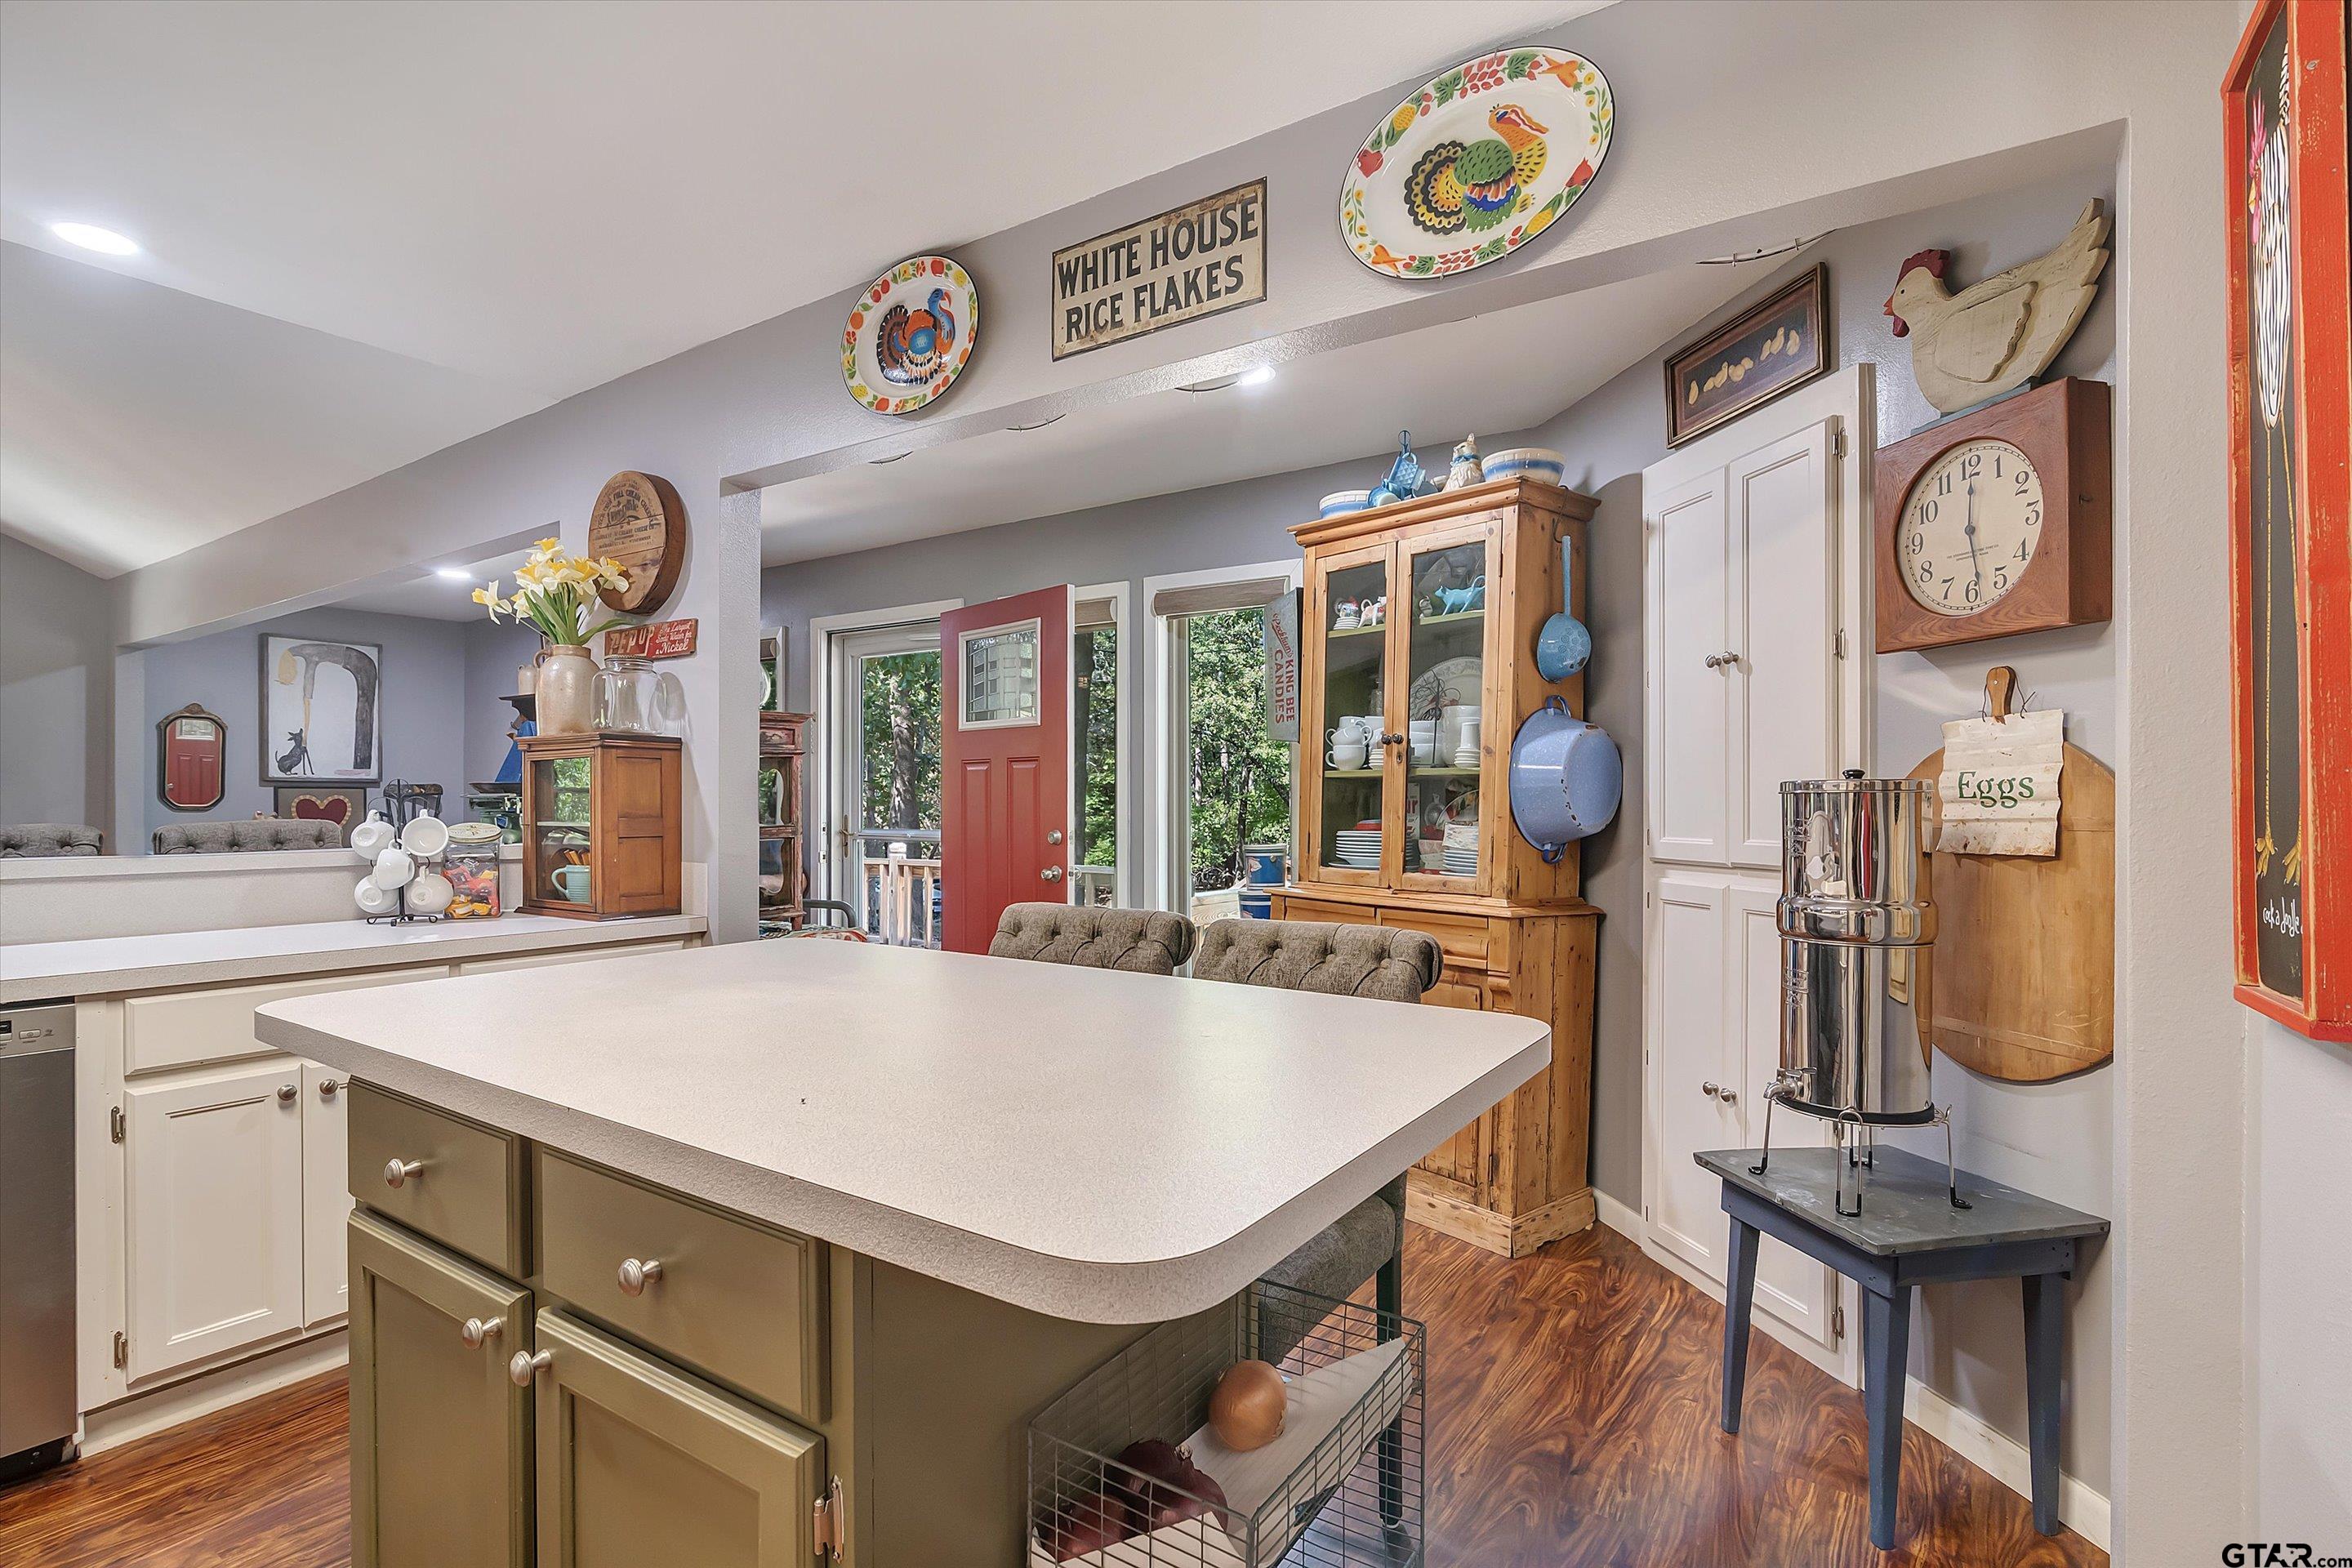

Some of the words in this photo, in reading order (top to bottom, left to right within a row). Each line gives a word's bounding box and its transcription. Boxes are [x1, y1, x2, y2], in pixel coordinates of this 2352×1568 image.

[1058, 234, 1141, 299] WHITE
[1150, 194, 1258, 270] HOUSE
[1066, 292, 1124, 343] RICE
[1133, 254, 1244, 323] FLAKES
[1960, 454, 1981, 481] 12
[1994, 454, 2002, 479] 1
[1937, 471, 1952, 497] 11
[2015, 470, 2029, 496] 2
[1918, 500, 1939, 525] 10
[2025, 500, 2040, 526] 3
[1912, 532, 1923, 555] 9
[2012, 537, 2029, 561] 4
[1920, 560, 1933, 582] 8
[1993, 565, 2007, 590] 5
[1940, 577, 1955, 600] 7
[1965, 580, 1979, 604] 6
[639, 626, 655, 656] UP
[660, 639, 689, 653] Nickel
[1275, 649, 1285, 724] CANDIES
[1285, 659, 1294, 693] KING
[1286, 697, 1294, 721] BEE
[1958, 772, 2034, 808] Eggs
[2275, 910, 2280, 925] a
